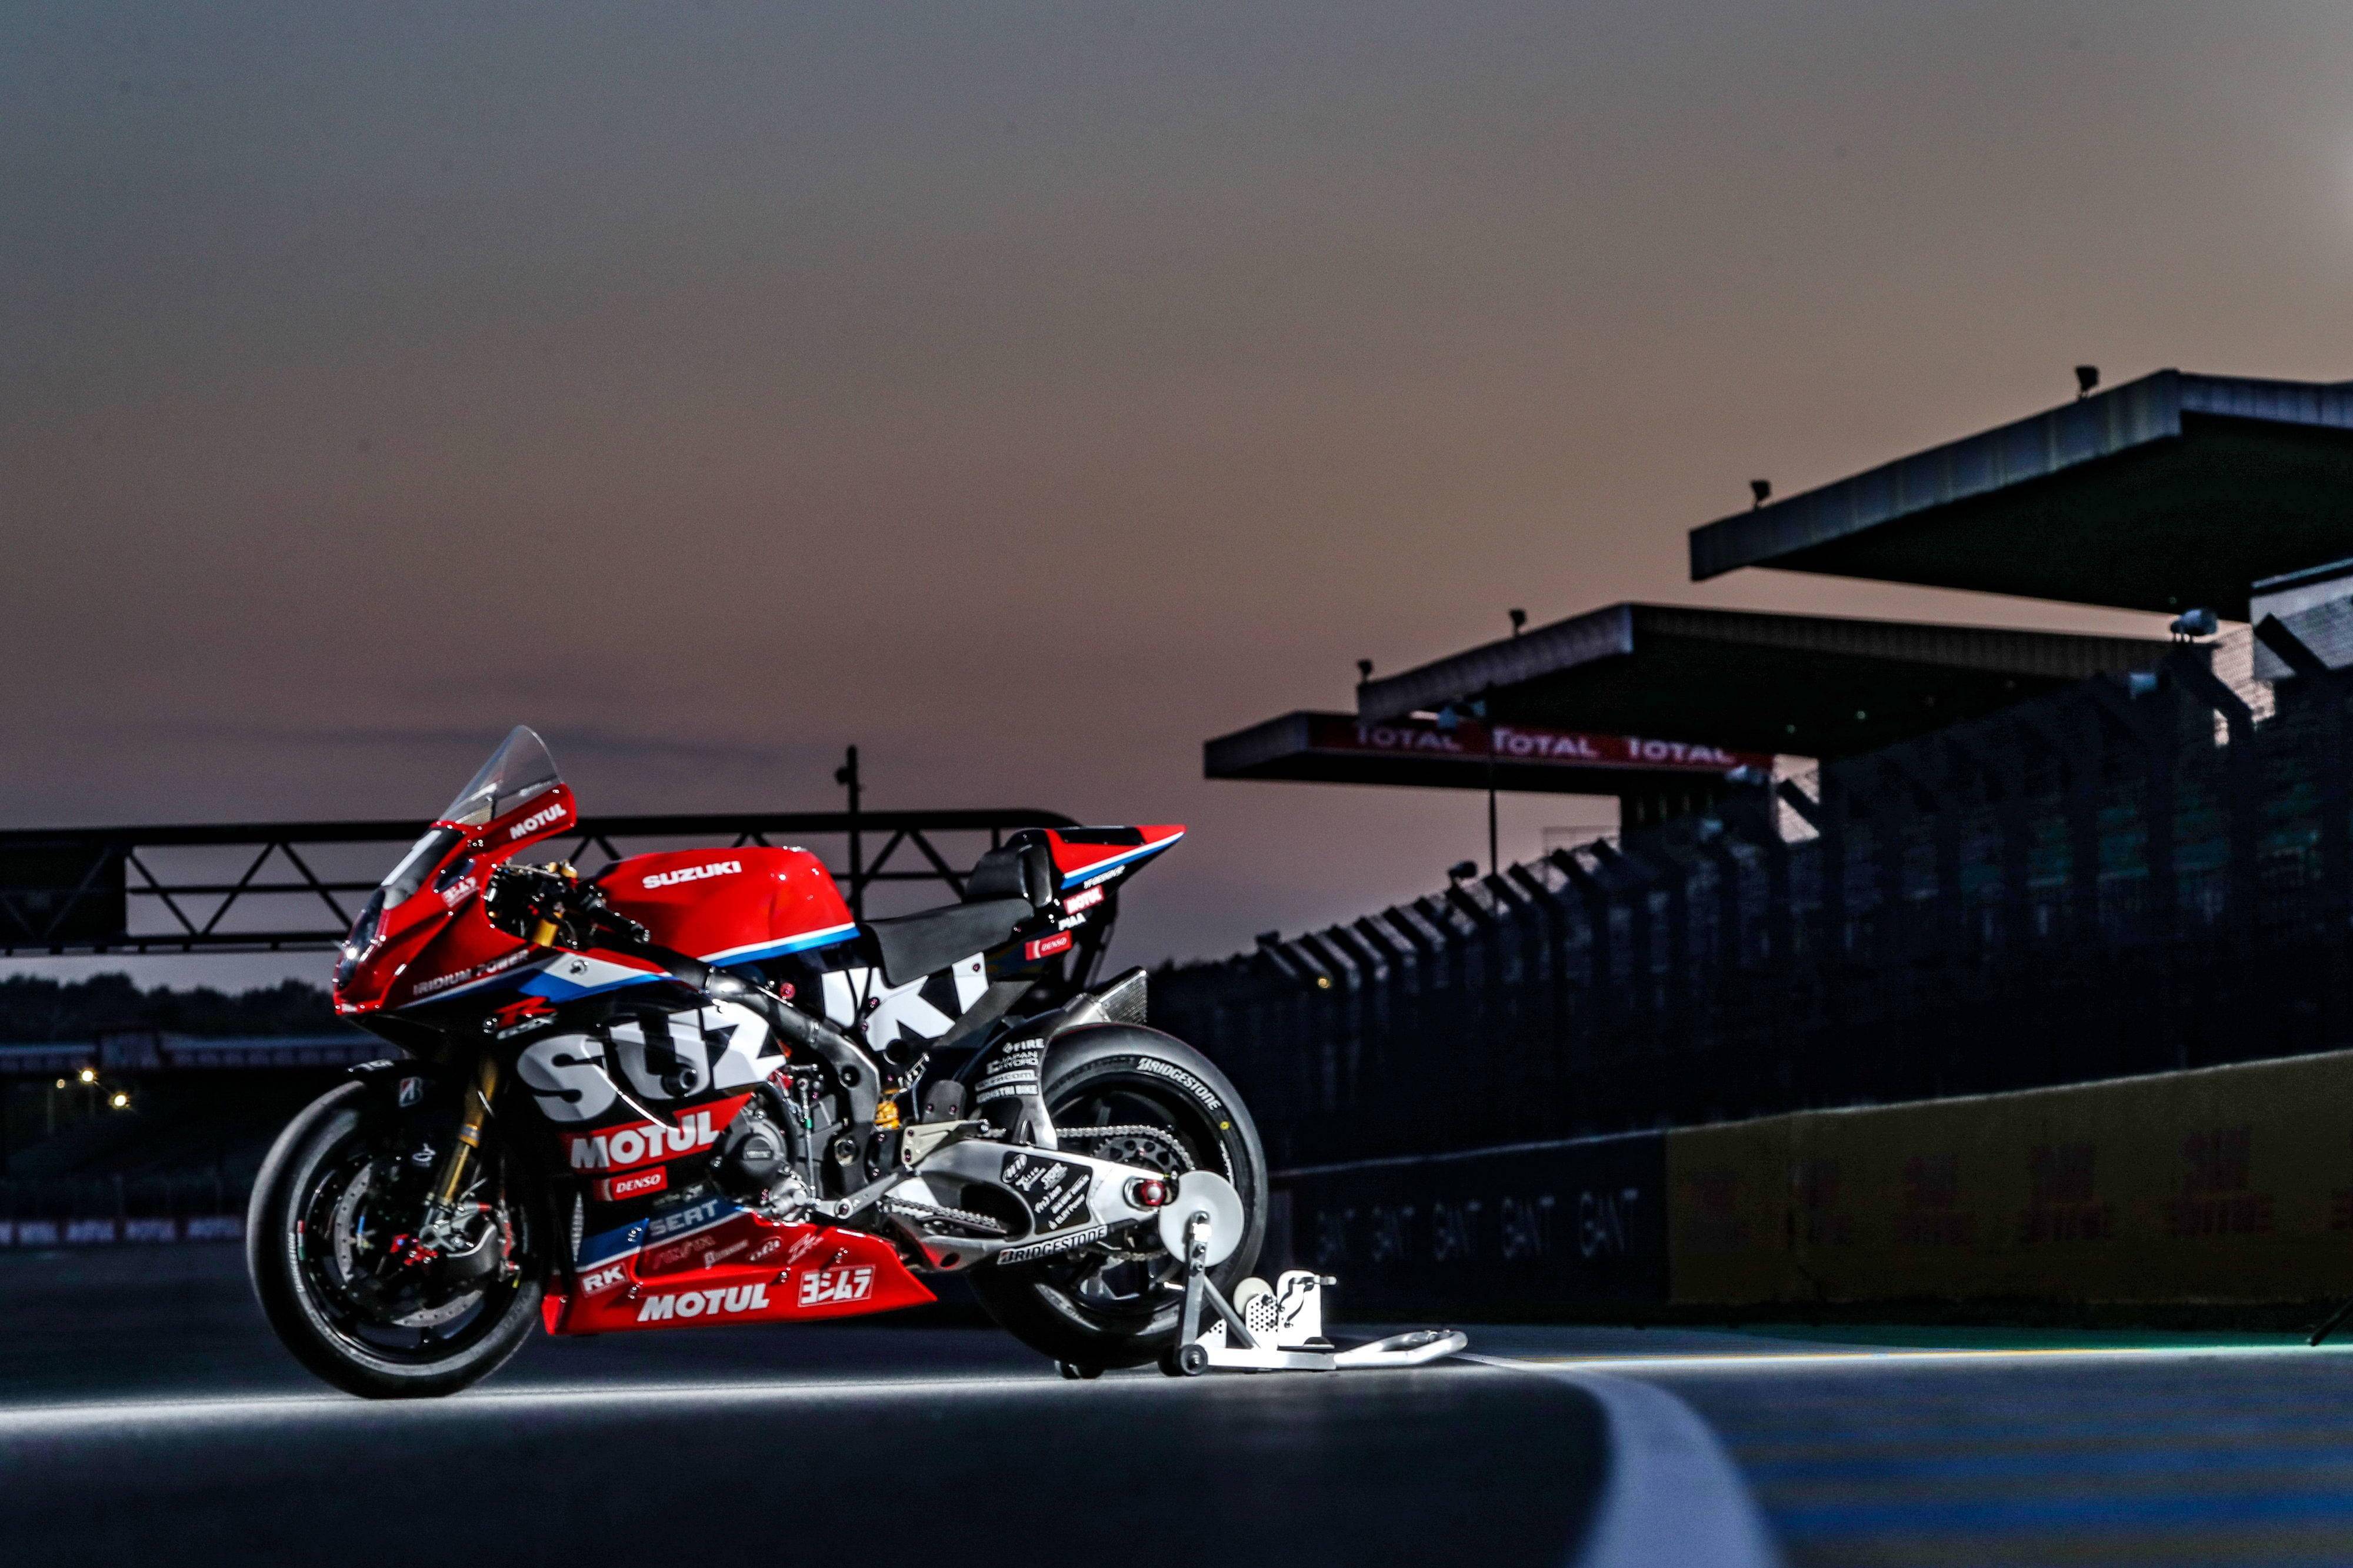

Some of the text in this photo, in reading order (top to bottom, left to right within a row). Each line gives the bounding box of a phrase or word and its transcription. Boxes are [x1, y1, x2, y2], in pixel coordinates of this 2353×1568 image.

[1355, 723, 1736, 764] TOTAL TOTAL TOTAL
[509, 803, 567, 840] MOTUL
[642, 860, 742, 889] SUZUKI
[1066, 888, 1102, 915] MOTUL
[1041, 936, 1068, 952] DENSO
[414, 968, 472, 996] IRIDIUM
[1136, 1057, 1222, 1111] BRIDGESTONE
[570, 1110, 720, 1169] MOTUL
[616, 1174, 661, 1193] DENSO
[648, 1198, 719, 1237] SERT
[1001, 1227, 1105, 1263] BRIDGESTONE
[582, 1266, 625, 1292] RK
[801, 1267, 872, 1305] ヨシムラ
[637, 1282, 771, 1322] MOTUL
